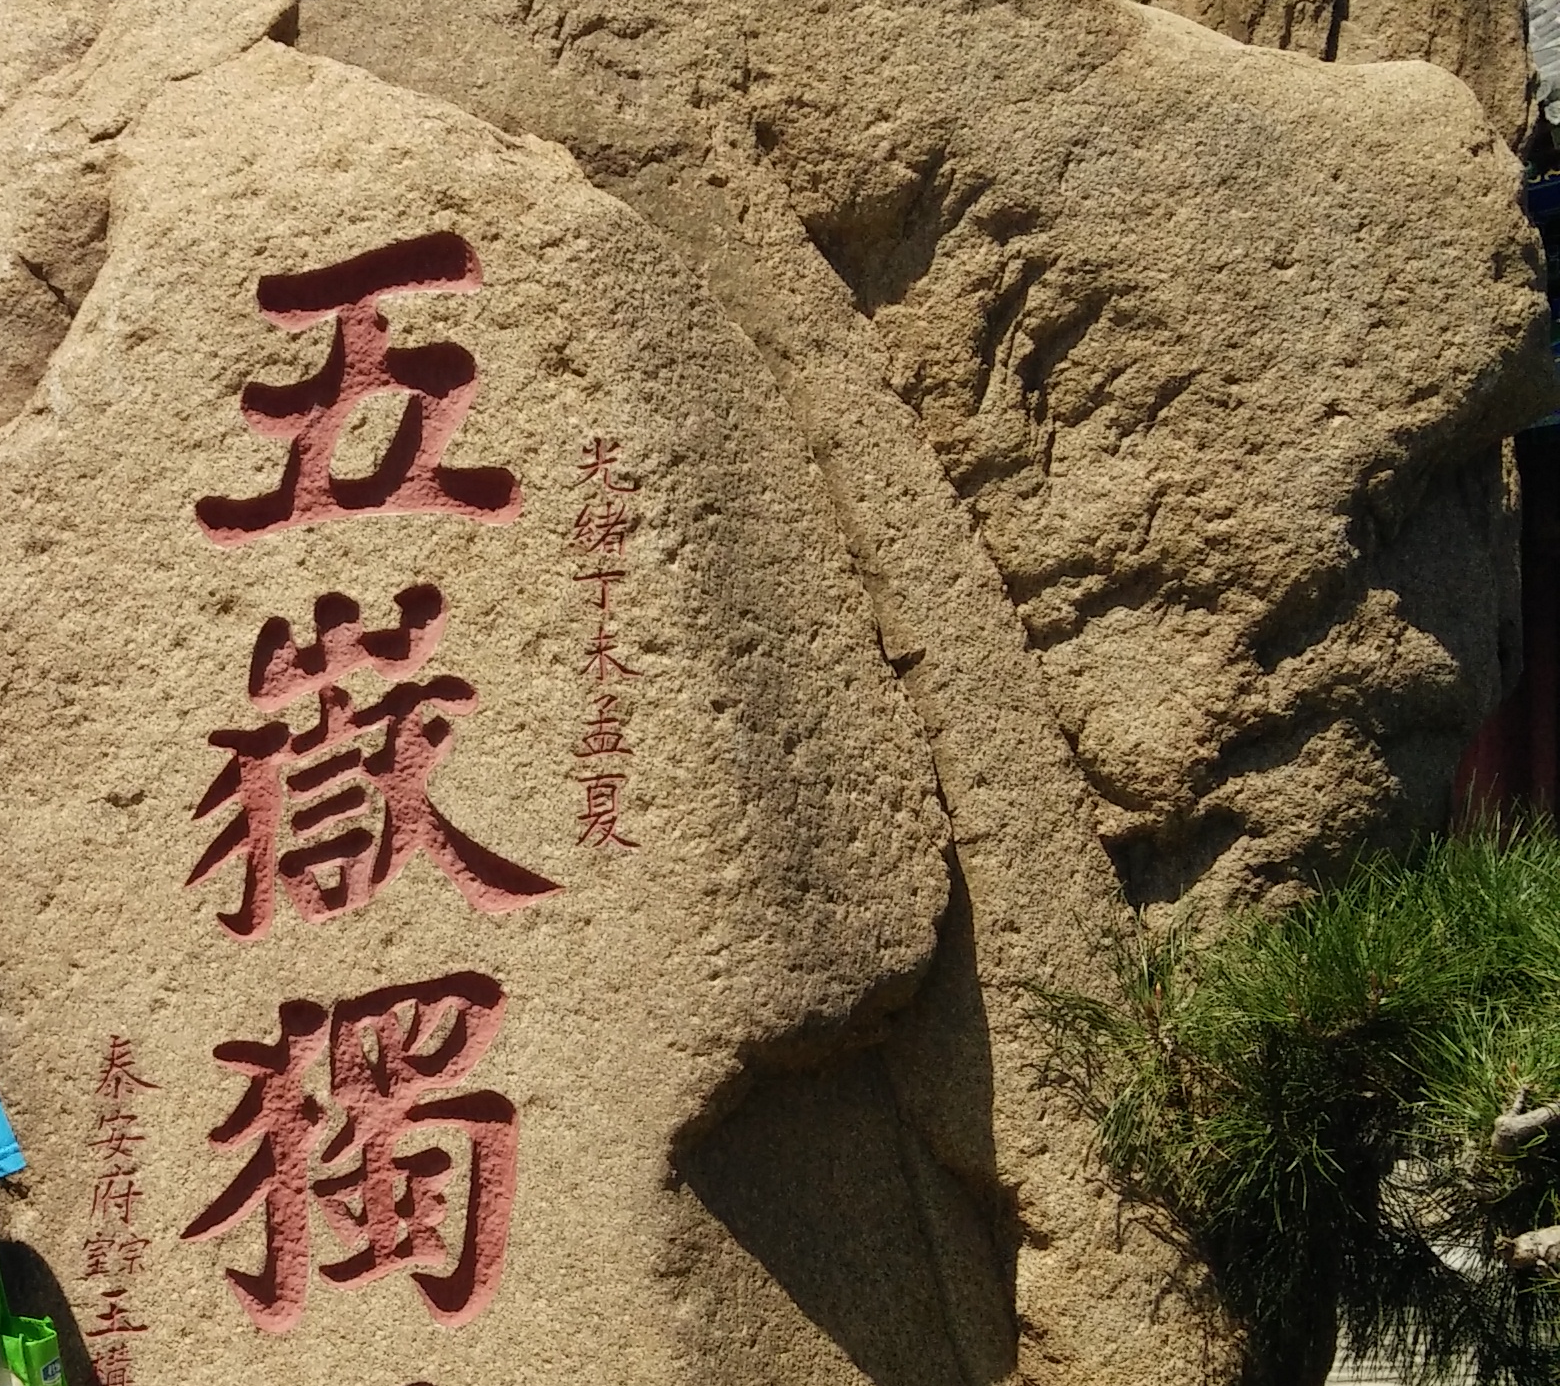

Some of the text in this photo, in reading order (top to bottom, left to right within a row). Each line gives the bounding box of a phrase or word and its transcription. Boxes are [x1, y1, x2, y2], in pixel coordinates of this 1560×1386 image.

[572, 437, 642, 849] 光緒丁未孟夏
